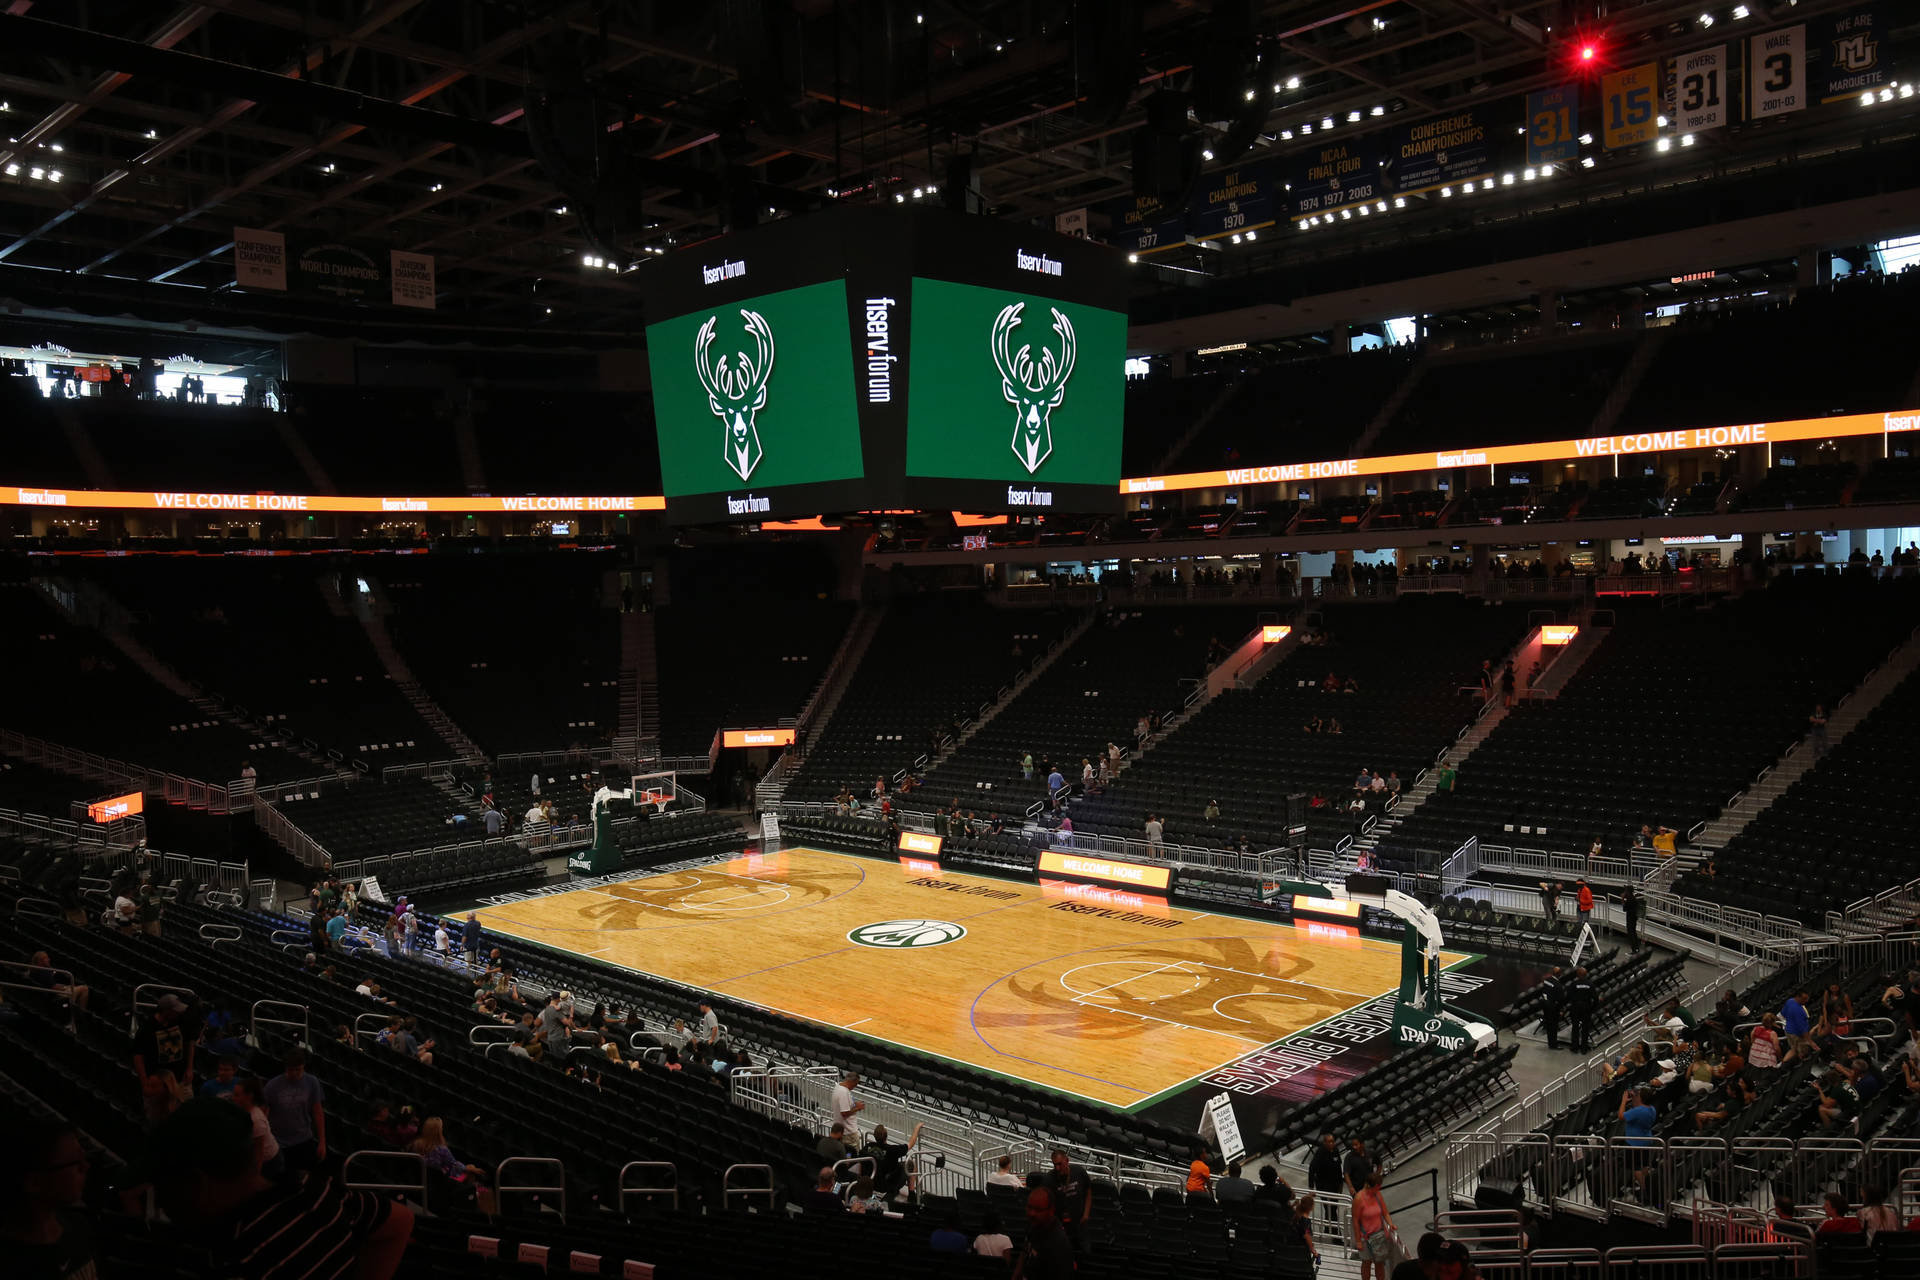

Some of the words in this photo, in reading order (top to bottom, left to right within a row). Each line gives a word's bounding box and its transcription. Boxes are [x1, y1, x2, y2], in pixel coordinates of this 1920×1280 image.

[1835, 16, 1851, 33] WE
[1853, 14, 1873, 28] ARE
[1765, 35, 1791, 50] WADE
[1836, 33, 1876, 71] MU
[1686, 54, 1716, 71] RIVERS
[1765, 52, 1792, 92] 3
[1683, 70, 1720, 112] 31
[1828, 71, 1882, 93] MARQUETTE
[1609, 87, 1652, 130] 15
[1763, 95, 1795, 111] 2001-03
[1409, 112, 1473, 141] CONFERENCE
[1533, 106, 1573, 147] 31
[1401, 126, 1485, 159] CHAMPIONSHIPS
[1321, 146, 1348, 163] NCAA
[1225, 172, 1240, 187] NIT
[1307, 162, 1335, 181] FINAL
[1336, 156, 1361, 175] FOUR
[1208, 180, 1258, 204] CHAMPIONS
[1300, 196, 1319, 212] 1974
[1323, 191, 1343, 206] 1977
[1349, 184, 1373, 200] 2003
[1223, 213, 1244, 229] 1970
[1138, 233, 1158, 248] 1977
[240, 249, 281, 264] CHAMPIONS
[1017, 248, 1062, 277] fiserv.forum
[300, 256, 330, 274] WORLD
[332, 263, 380, 281] CHAMPIONS
[703, 259, 746, 285] fiserv.forum
[866, 297, 897, 403] fiserv.forum
[1575, 430, 1687, 456] WELCOME
[1695, 424, 1766, 445] HOME
[1226, 466, 1304, 484] WELCOME
[1309, 460, 1358, 478] HOME
[154, 492, 250, 509] WELCOME
[256, 494, 308, 510] HOME
[501, 497, 583, 511] WELCOME
[588, 497, 634, 510] HOME
[727, 494, 770, 515] fiserv.forum
[1007, 485, 1052, 507] fiserv.forum
[1063, 859, 1112, 875] WELCOME
[1113, 866, 1144, 880] HOME
[1048, 900, 1184, 928] fiserv.forum
[1216, 1107, 1231, 1118] PLEASE
[1224, 1114, 1232, 1122] NOT
[1219, 1123, 1229, 1131] WALK
[1223, 1134, 1238, 1145] COURTS
